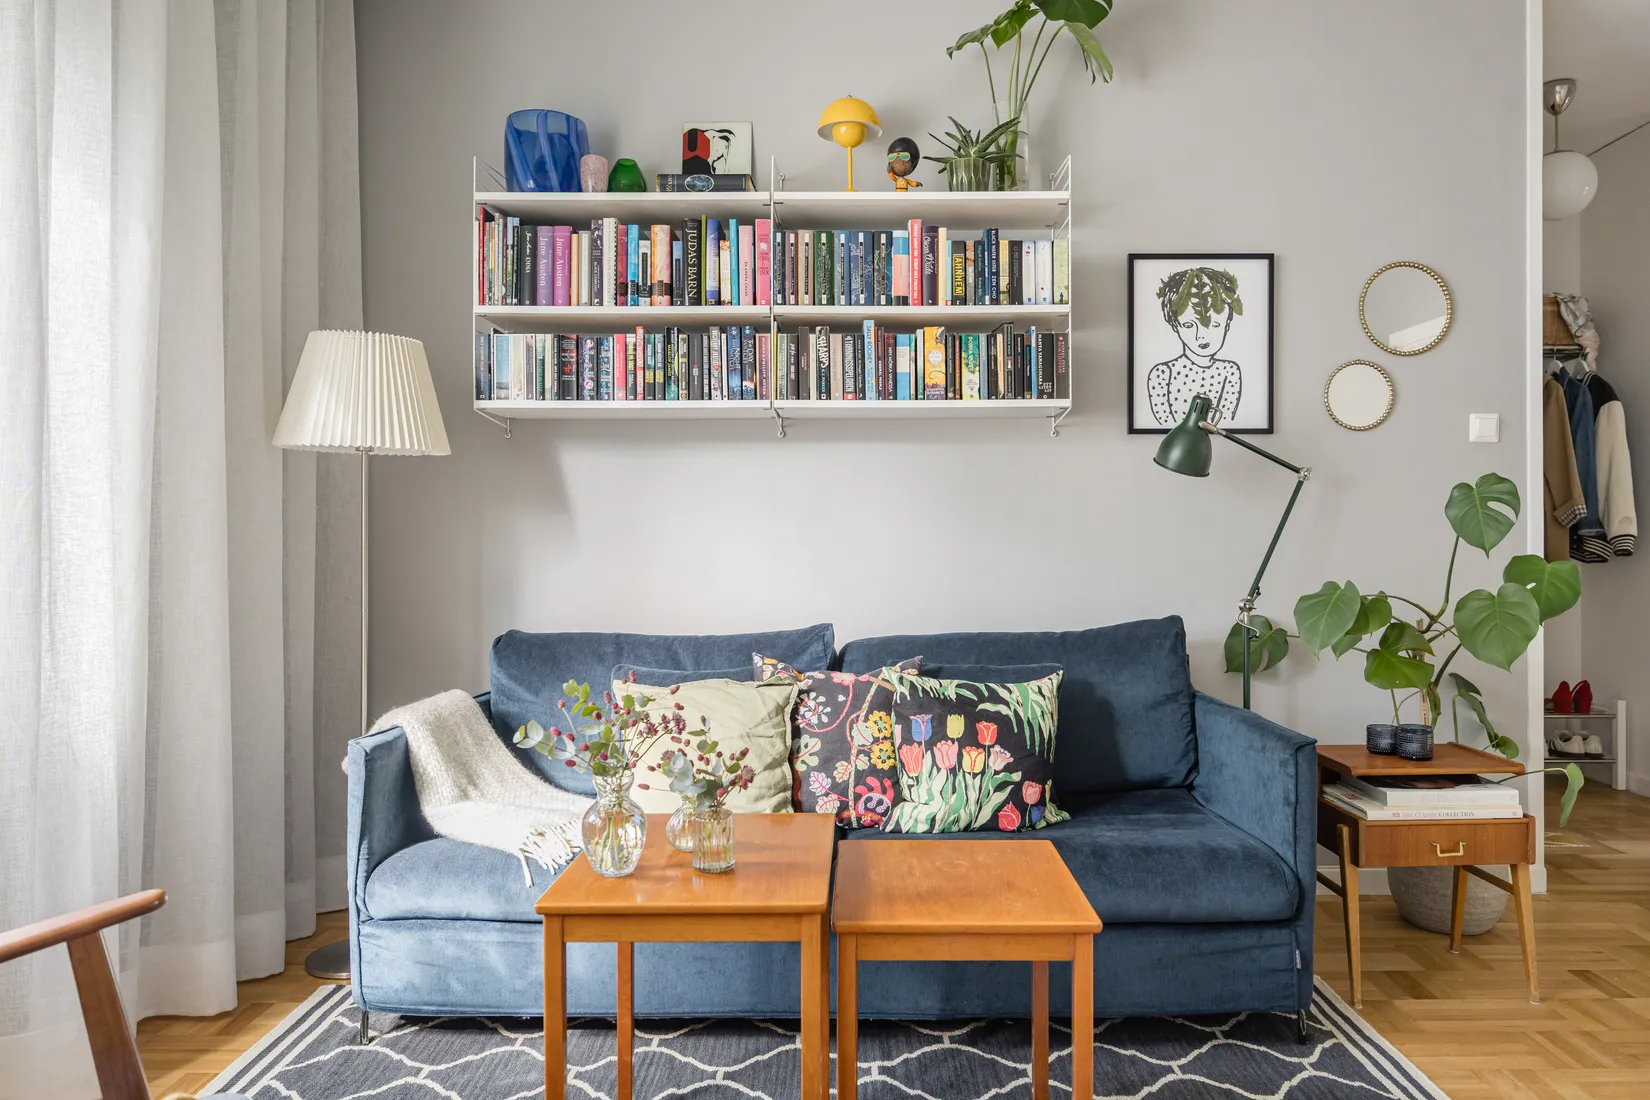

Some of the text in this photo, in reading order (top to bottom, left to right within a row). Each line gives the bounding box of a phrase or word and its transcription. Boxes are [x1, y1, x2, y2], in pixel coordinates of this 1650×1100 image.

[540, 237, 548, 286] Jane Austen
[556, 238, 564, 286] Jane Austen
[686, 228, 698, 298] JUDAS BARN
[924, 253, 934, 275] Wilde
[817, 336, 829, 368] SHARPS
